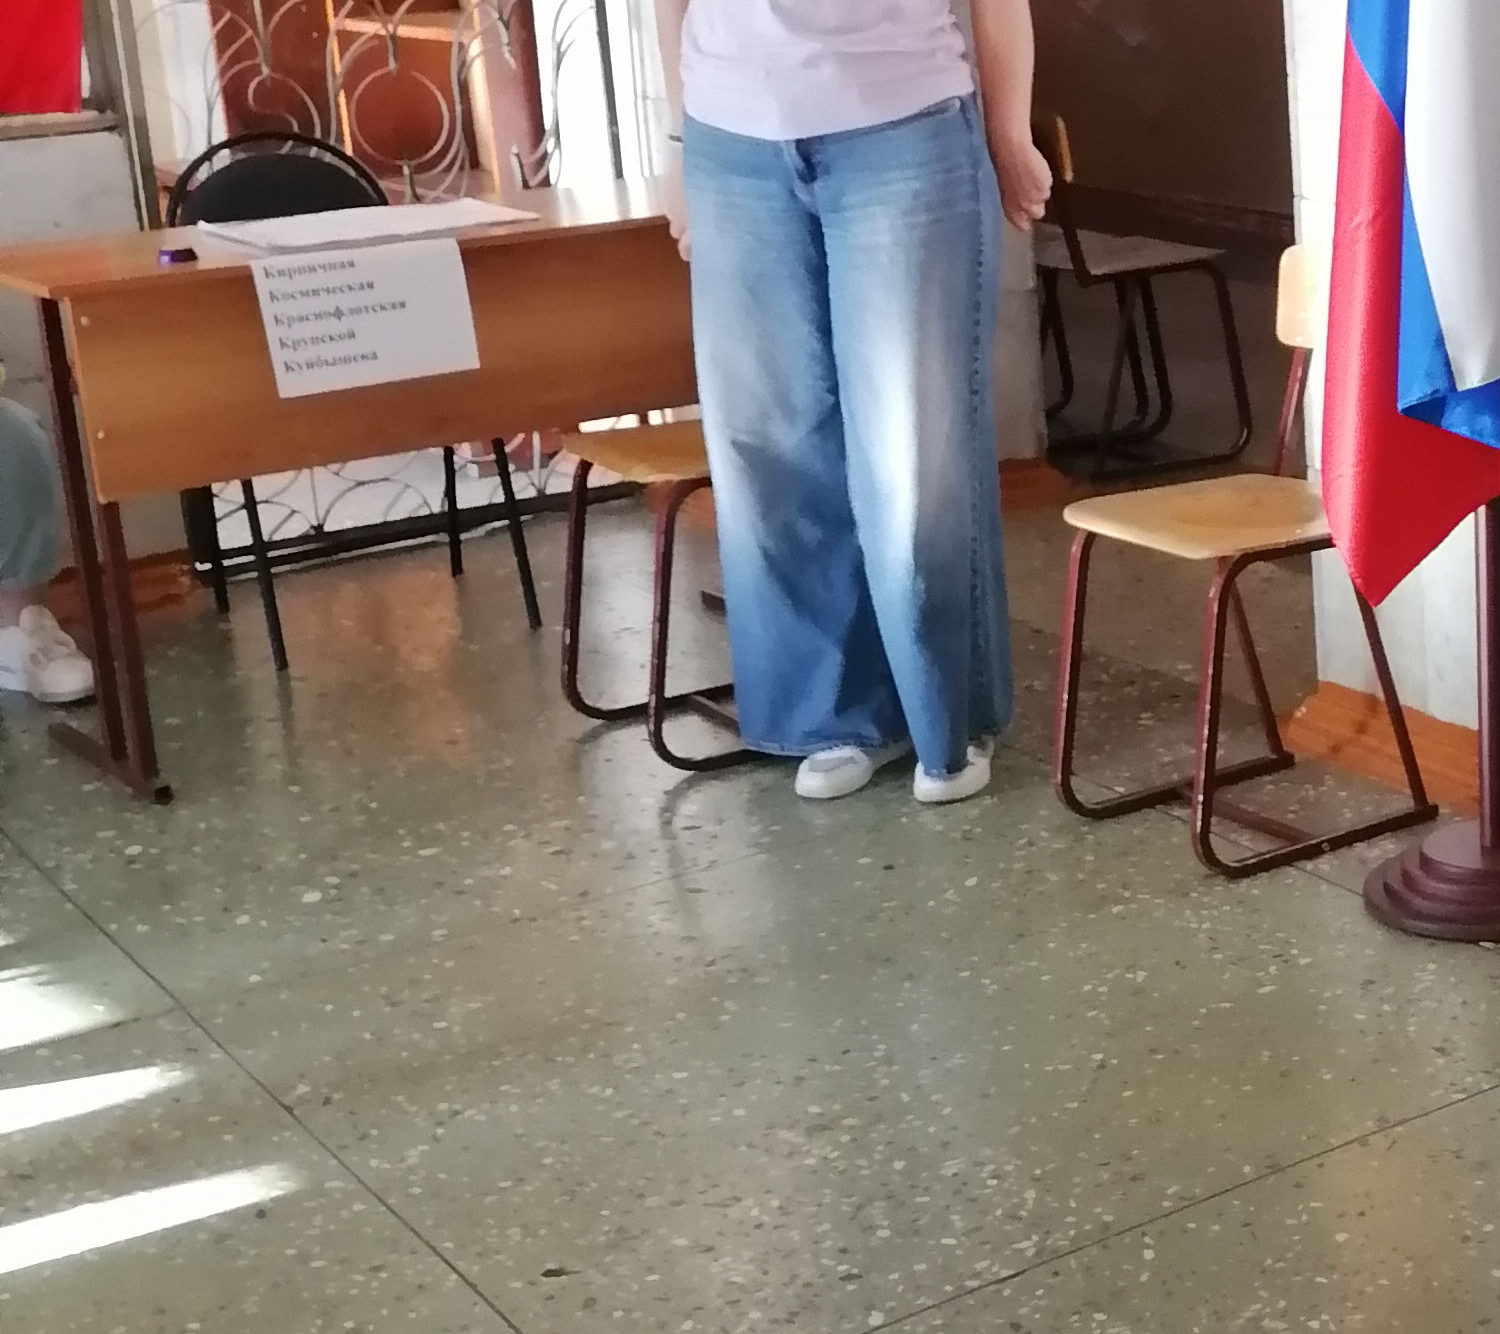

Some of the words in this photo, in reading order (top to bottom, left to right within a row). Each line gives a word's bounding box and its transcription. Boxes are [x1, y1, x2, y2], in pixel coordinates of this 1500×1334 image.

[263, 259, 356, 279] Кирпичная
[269, 280, 375, 303] Космическая
[273, 301, 406, 328] Краснофлотская
[279, 328, 356, 352] Крупской
